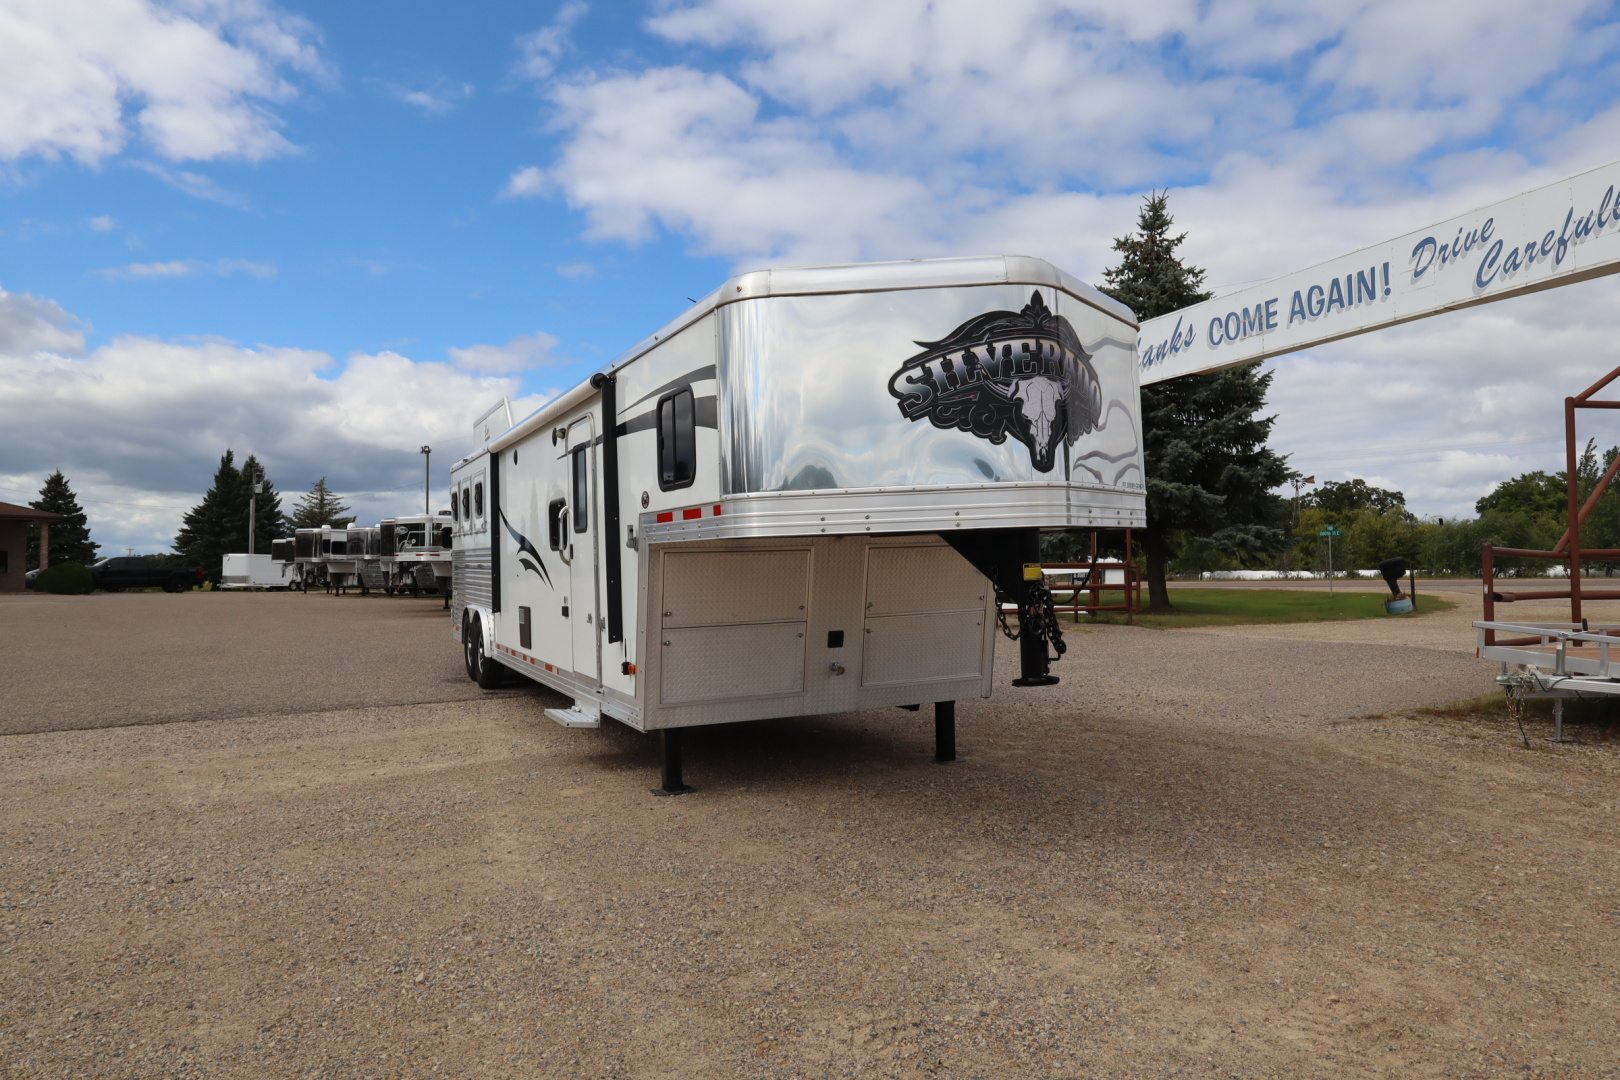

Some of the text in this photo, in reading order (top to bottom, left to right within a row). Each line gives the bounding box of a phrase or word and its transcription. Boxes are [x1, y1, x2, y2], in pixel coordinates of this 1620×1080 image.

[1138, 217, 1495, 368] anks COME AGAIN! Drive
[893, 337, 1101, 412] SILVERADO
